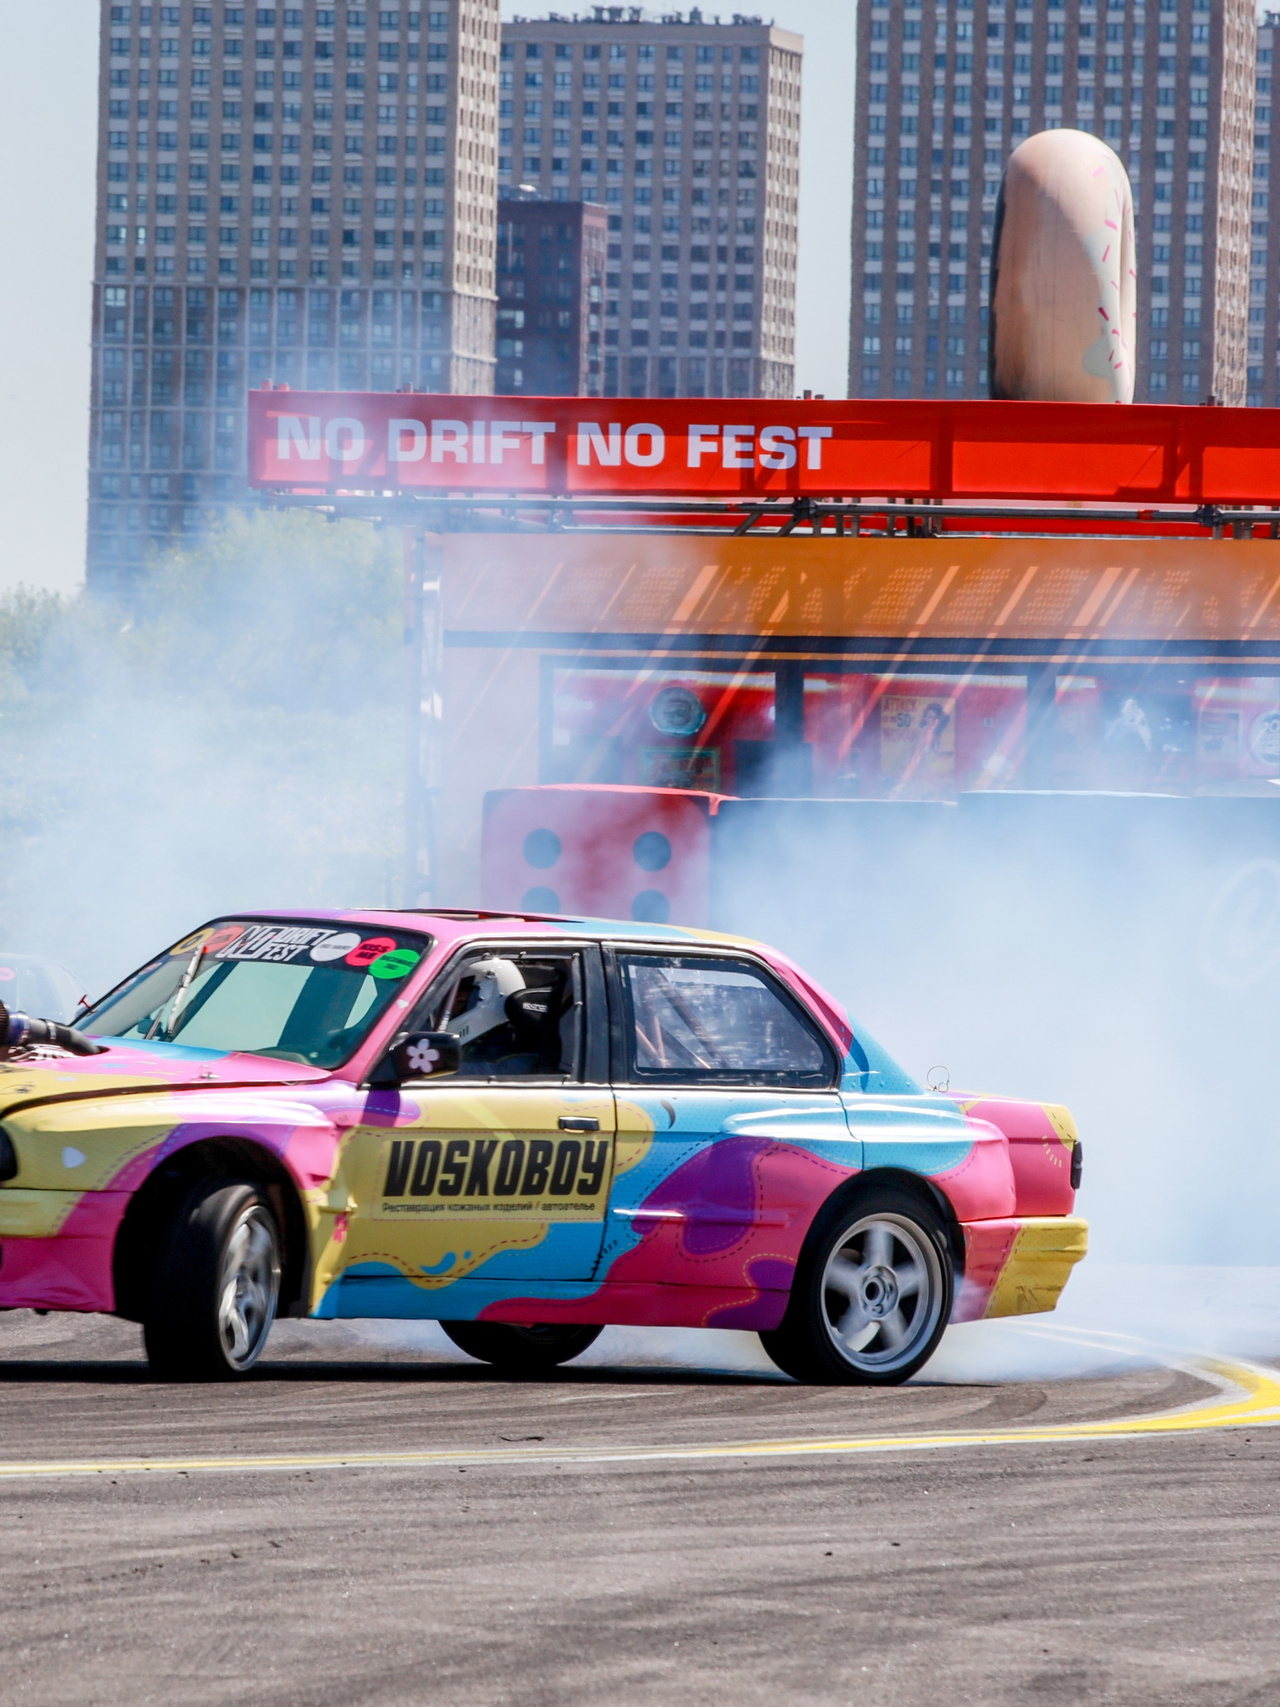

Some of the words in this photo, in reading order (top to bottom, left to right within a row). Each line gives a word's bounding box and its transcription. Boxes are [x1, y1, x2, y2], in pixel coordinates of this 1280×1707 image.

[277, 415, 365, 461] NO
[387, 418, 556, 465] DRIFT
[576, 422, 665, 468] NO
[687, 424, 833, 470] FEST
[261, 944, 310, 962] FEST
[272, 926, 337, 946] DRIFT
[383, 1139, 608, 1197] VOSKOBOY
